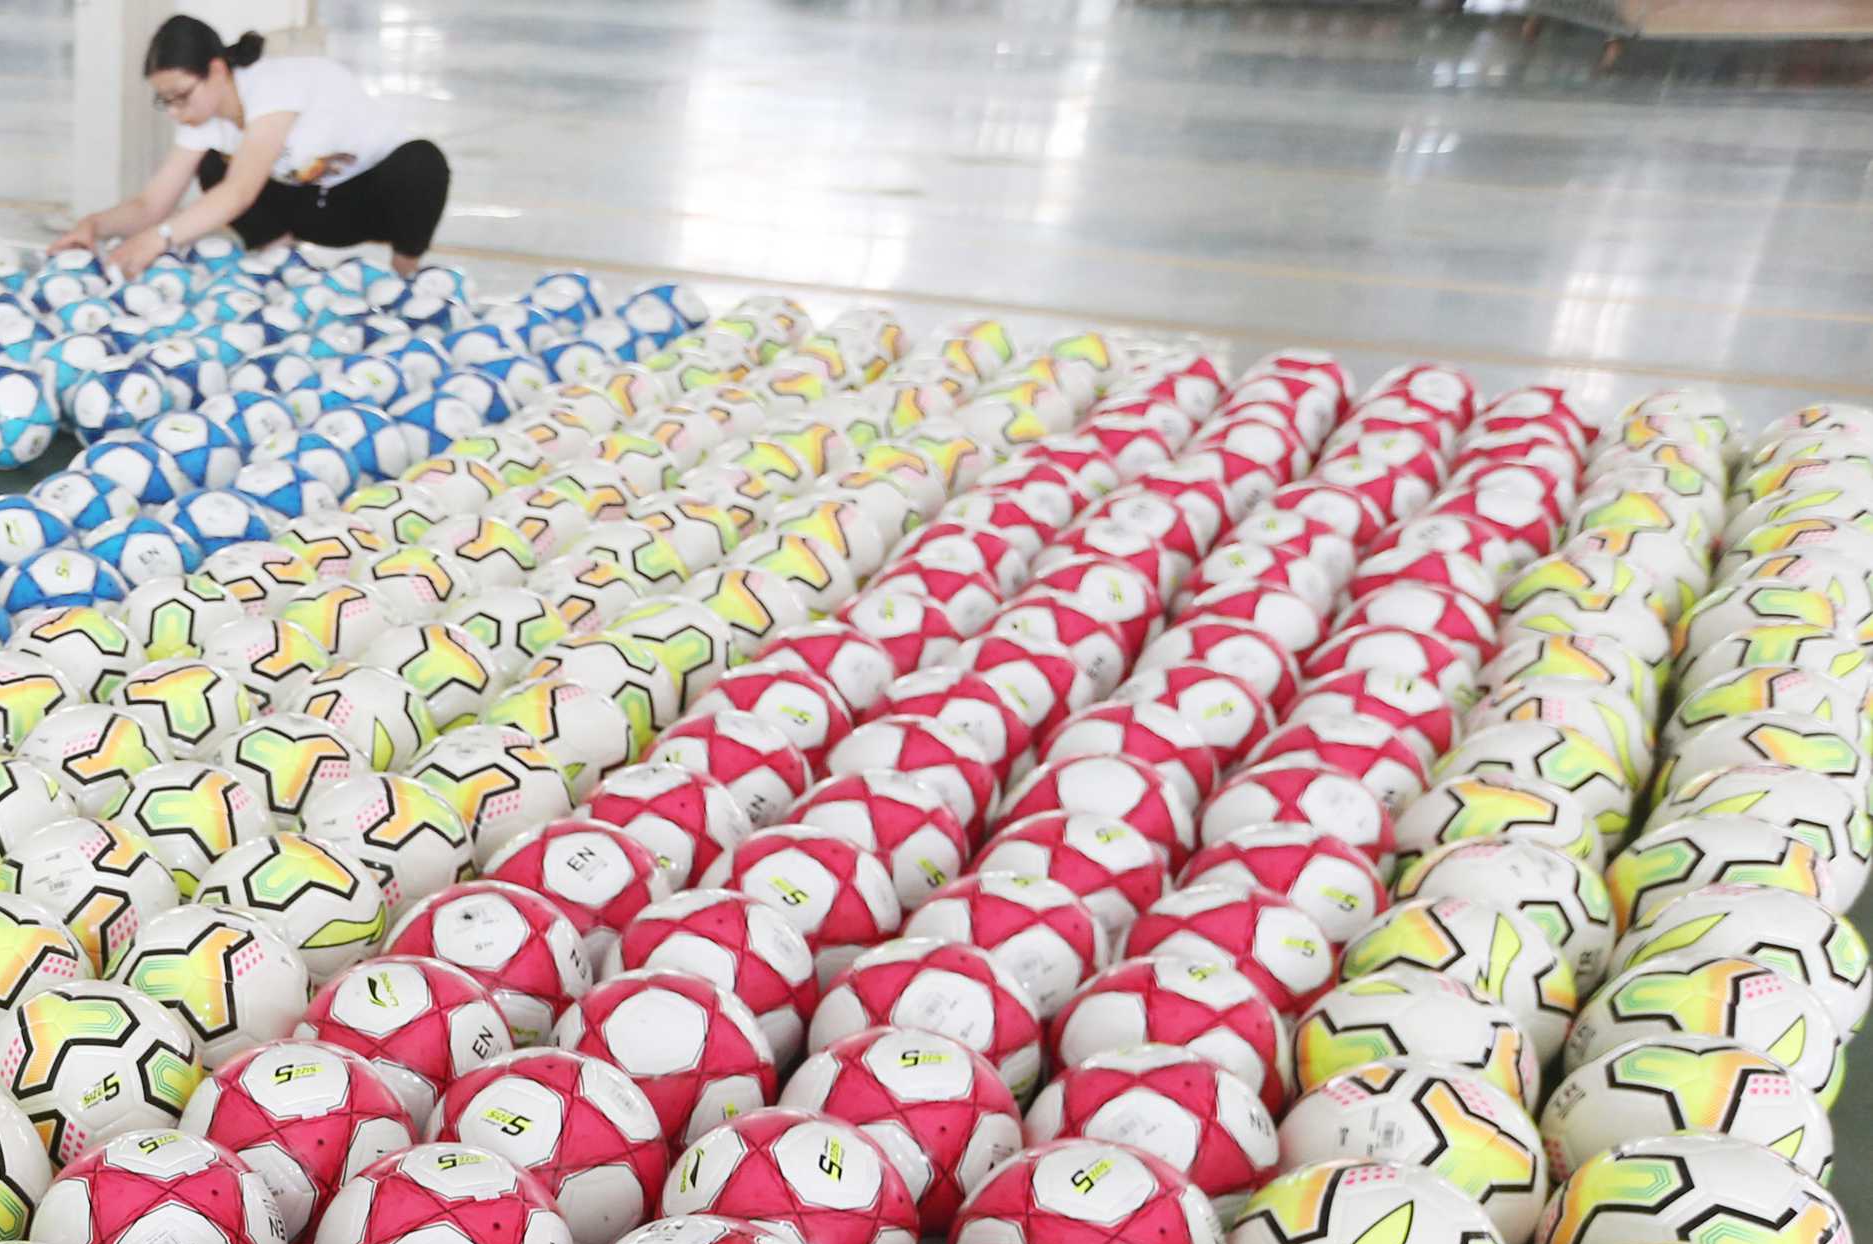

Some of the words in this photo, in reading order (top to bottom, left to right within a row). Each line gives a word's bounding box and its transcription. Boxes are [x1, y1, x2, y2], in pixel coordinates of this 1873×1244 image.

[566, 846, 597, 871] EN
[472, 1025, 496, 1059] EN
[899, 1050, 920, 1067] 5
[274, 1064, 295, 1085] 5
[83, 1087, 104, 1104] SIZE
[103, 1072, 120, 1101] 5
[501, 1116, 532, 1136] 5
[138, 1137, 160, 1155] 5
[437, 1153, 457, 1170] 5
[818, 1154, 843, 1181] 5
[1070, 1170, 1095, 1194] 5
